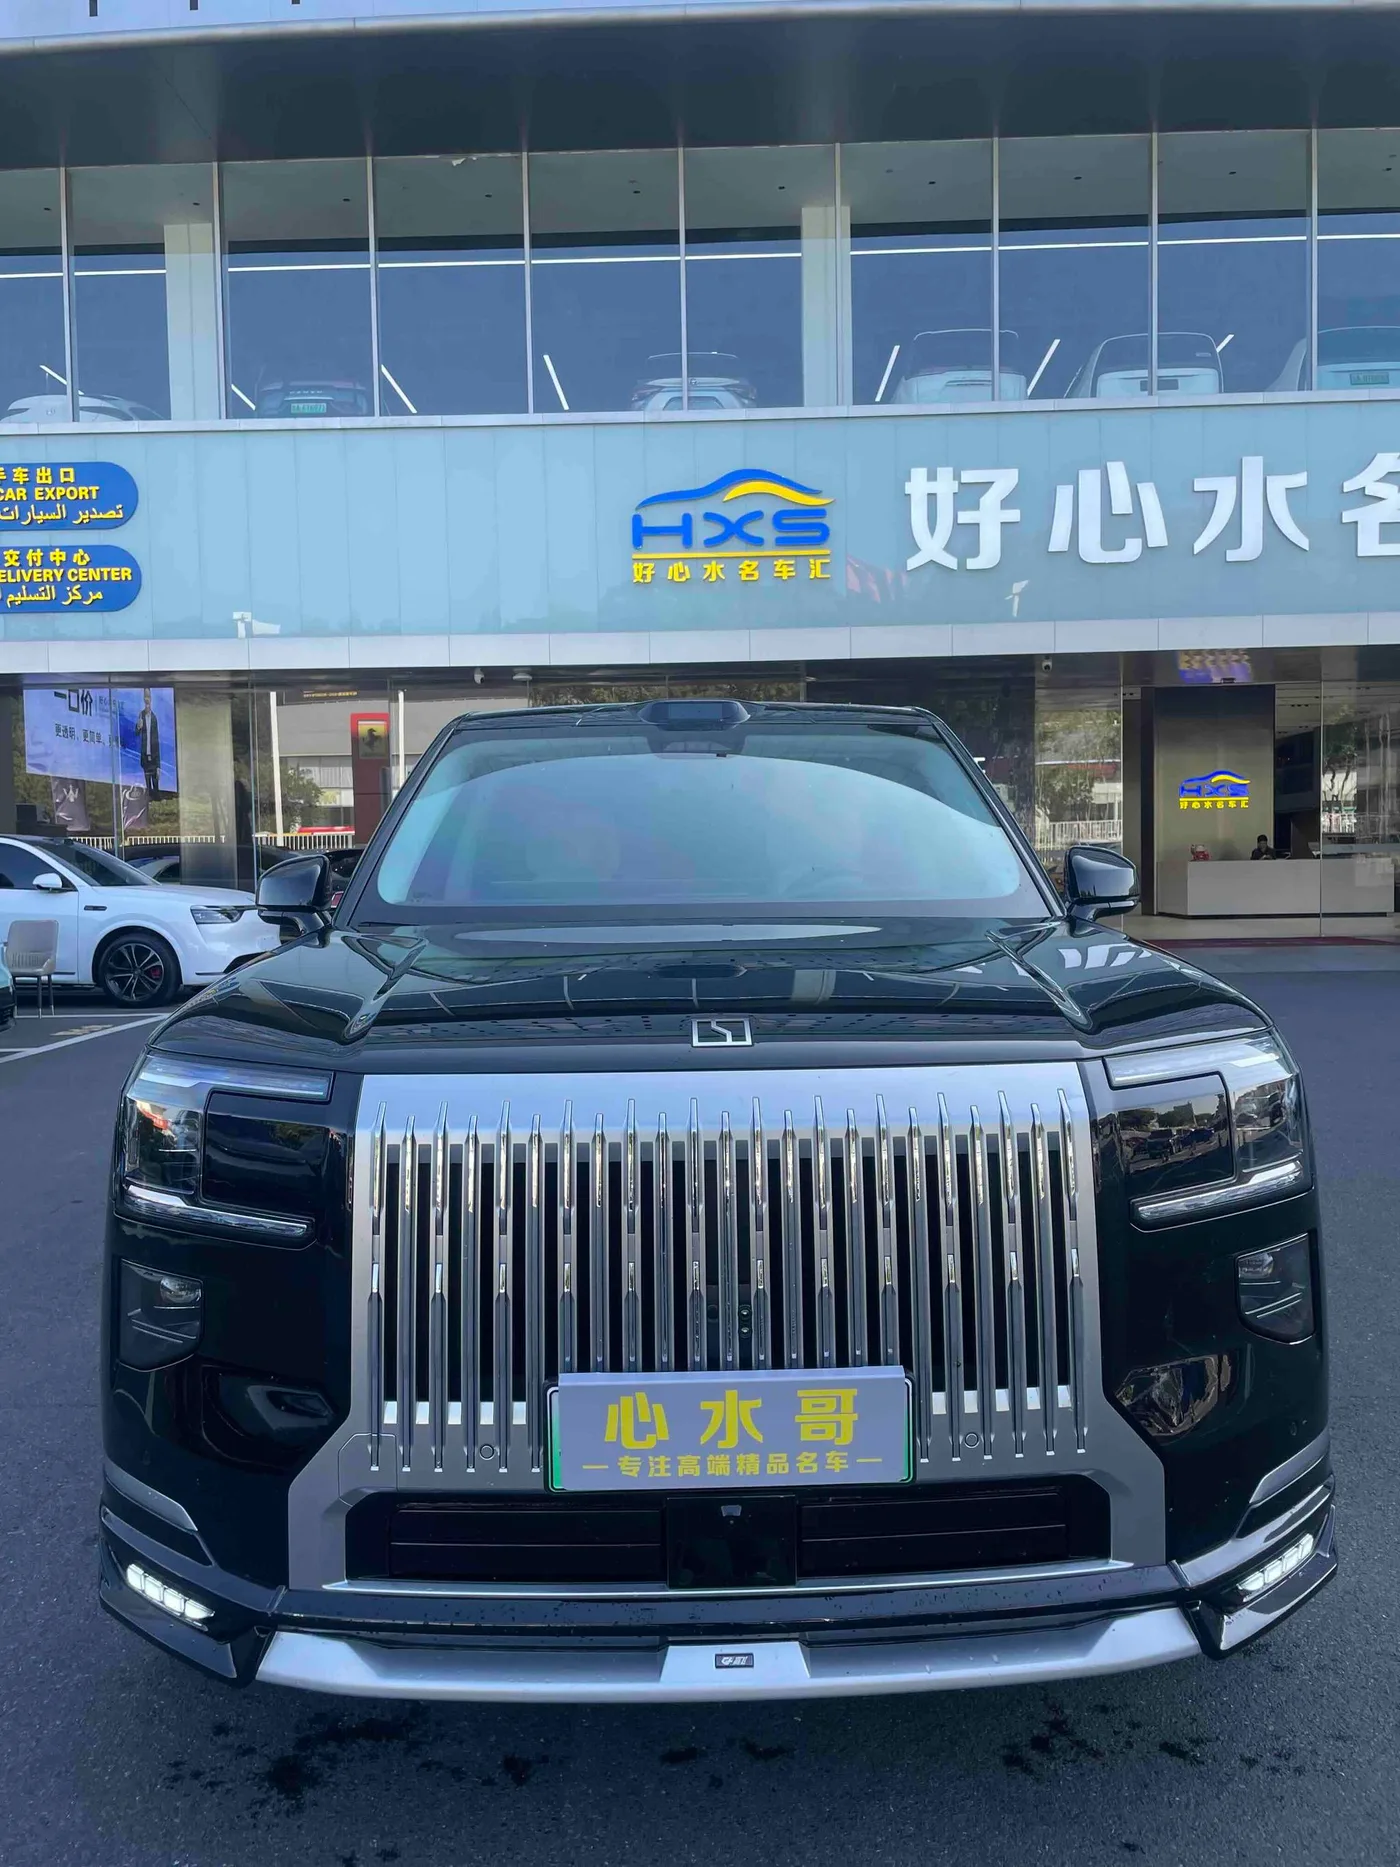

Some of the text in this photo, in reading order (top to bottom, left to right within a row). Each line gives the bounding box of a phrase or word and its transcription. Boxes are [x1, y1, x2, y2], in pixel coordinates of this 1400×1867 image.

[34, 486, 99, 500] EXPORT
[72, 504, 124, 524] تصدير
[632, 508, 830, 549] HXS
[4, 548, 91, 567] 交付中心
[67, 567, 132, 582] CENTER
[632, 559, 831, 583] 好心水名车汇
[6, 584, 103, 608] مركز التسليم
[54, 689, 93, 717] 一口价
[1180, 784, 1248, 797] HXS
[604, 1388, 858, 1450] 心水哥
[617, 1450, 850, 1478] 专注高端精品名车
